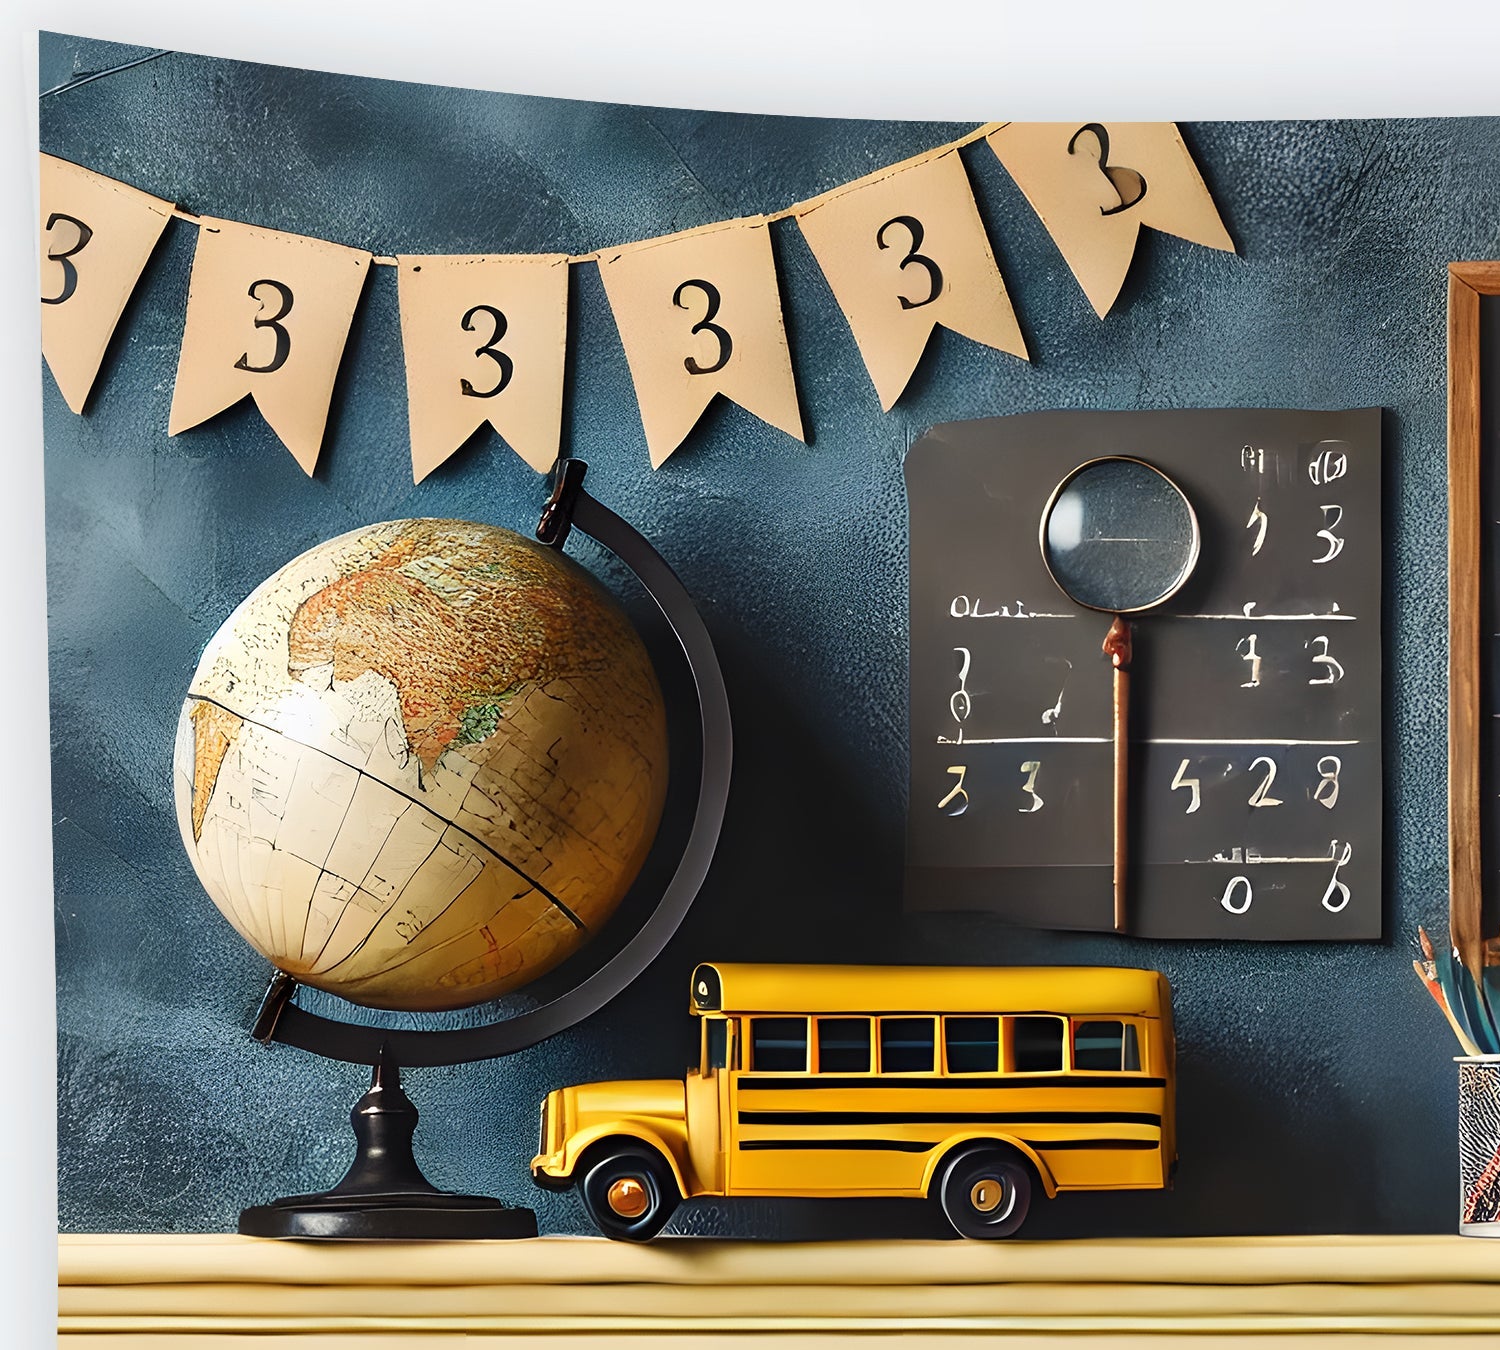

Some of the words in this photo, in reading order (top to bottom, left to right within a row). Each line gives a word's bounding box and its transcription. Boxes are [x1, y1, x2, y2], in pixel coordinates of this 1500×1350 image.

[40, 213, 94, 305] 3
[876, 215, 944, 310] 3
[234, 279, 295, 373] 3
[459, 304, 515, 398] 3
[673, 279, 733, 375] 3
